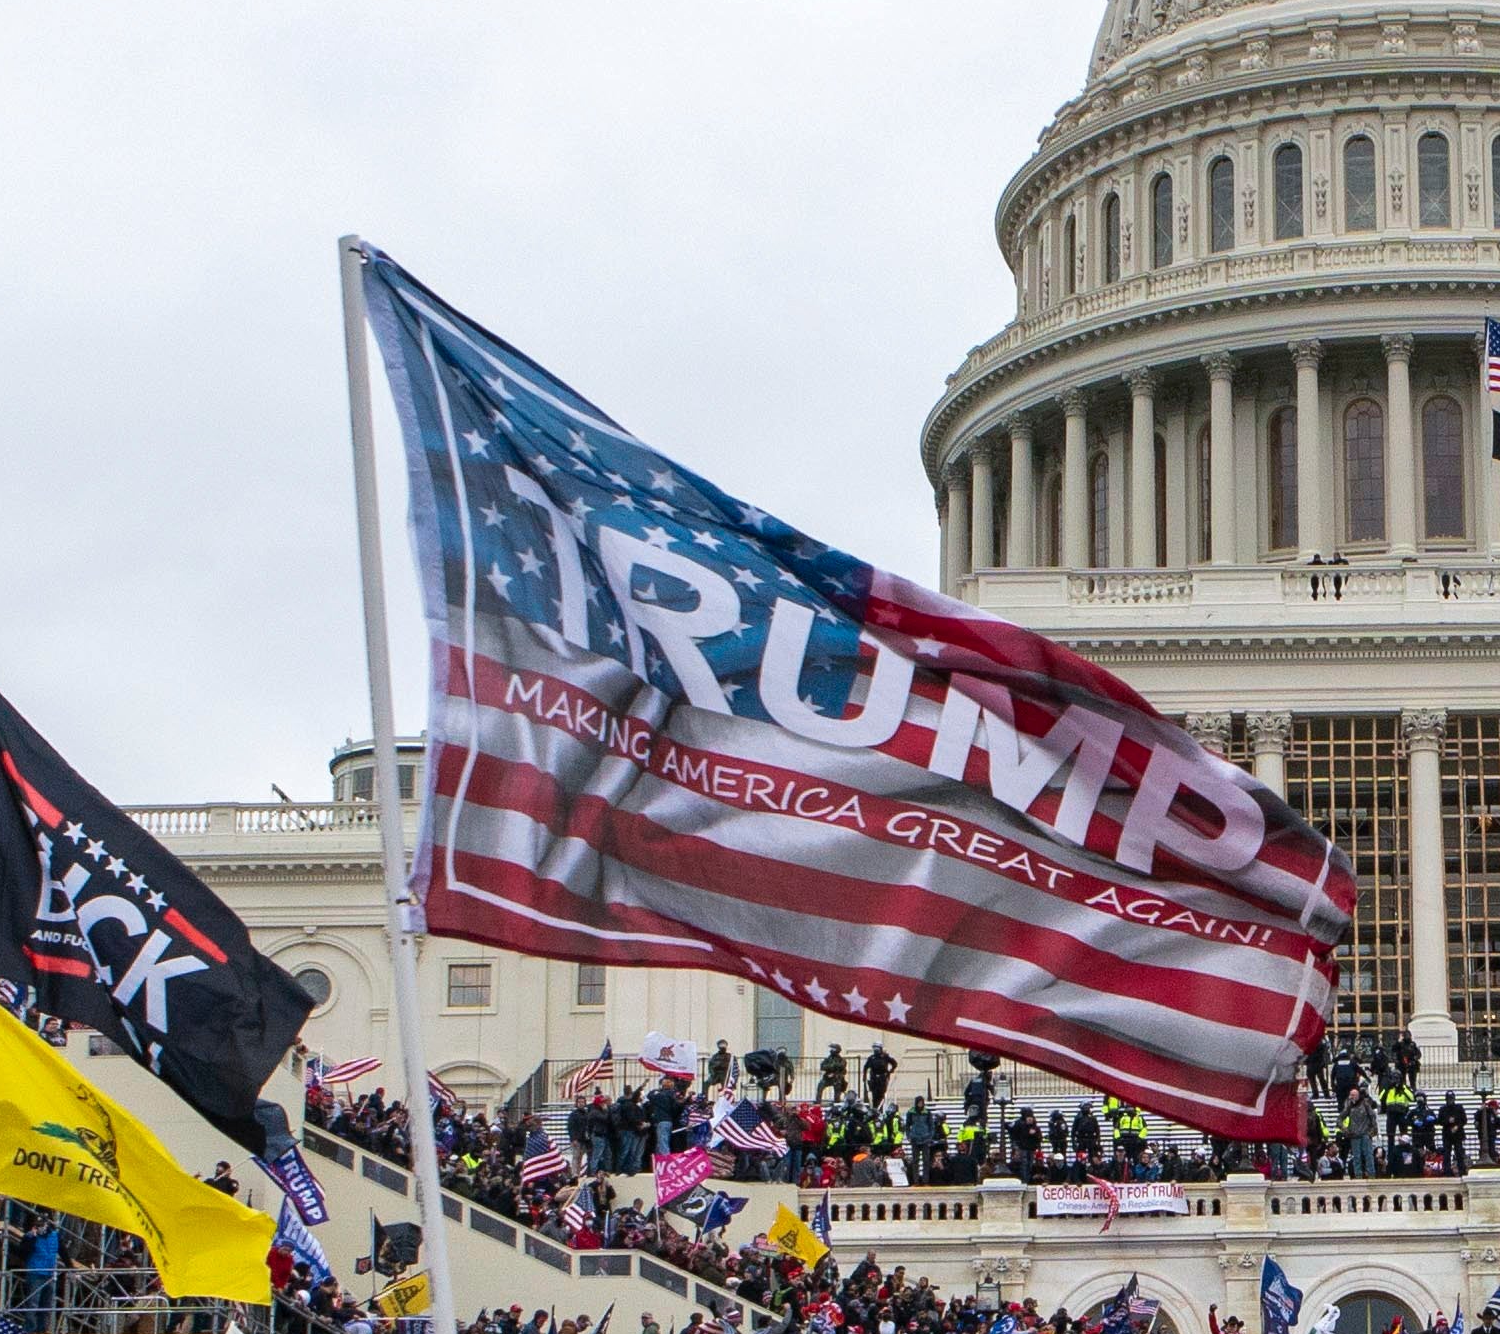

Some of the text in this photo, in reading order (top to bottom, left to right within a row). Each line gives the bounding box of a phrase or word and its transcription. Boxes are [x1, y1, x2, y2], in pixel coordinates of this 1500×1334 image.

[504, 466, 1267, 874] TRUMP
[506, 671, 1273, 947] MAKING AMERICA GREAT AGAIN!
[30, 929, 61, 944] AND
[12, 1147, 71, 1176] DONT
[281, 1148, 324, 1221] TRUMP
[1043, 1186, 1090, 1201] GEORGIA
[1093, 1185, 1123, 1201] FIGT
[1127, 1185, 1149, 1199] FOR
